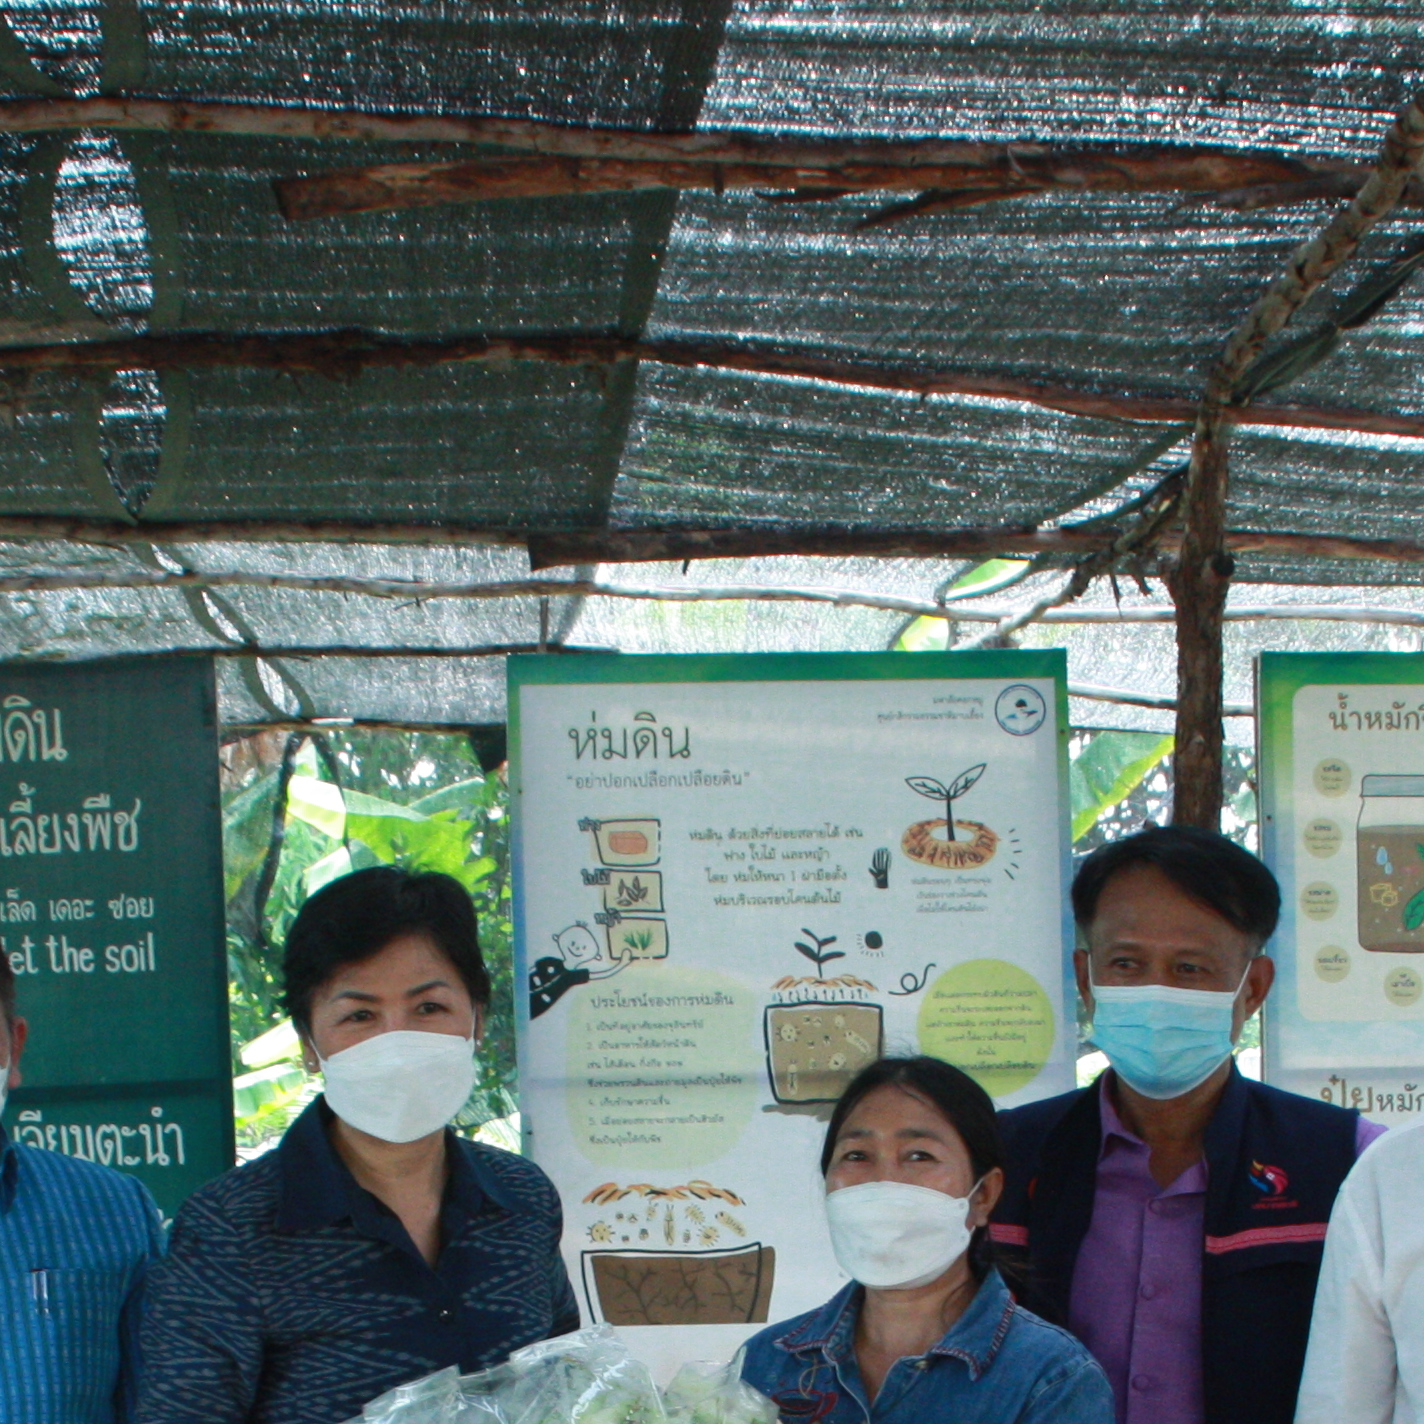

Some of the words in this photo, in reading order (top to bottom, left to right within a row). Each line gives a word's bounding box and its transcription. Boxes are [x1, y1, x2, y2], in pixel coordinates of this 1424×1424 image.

[568, 711, 691, 759] ห่มดิน
[45, 934, 95, 973] the
[105, 931, 156, 973] soil
